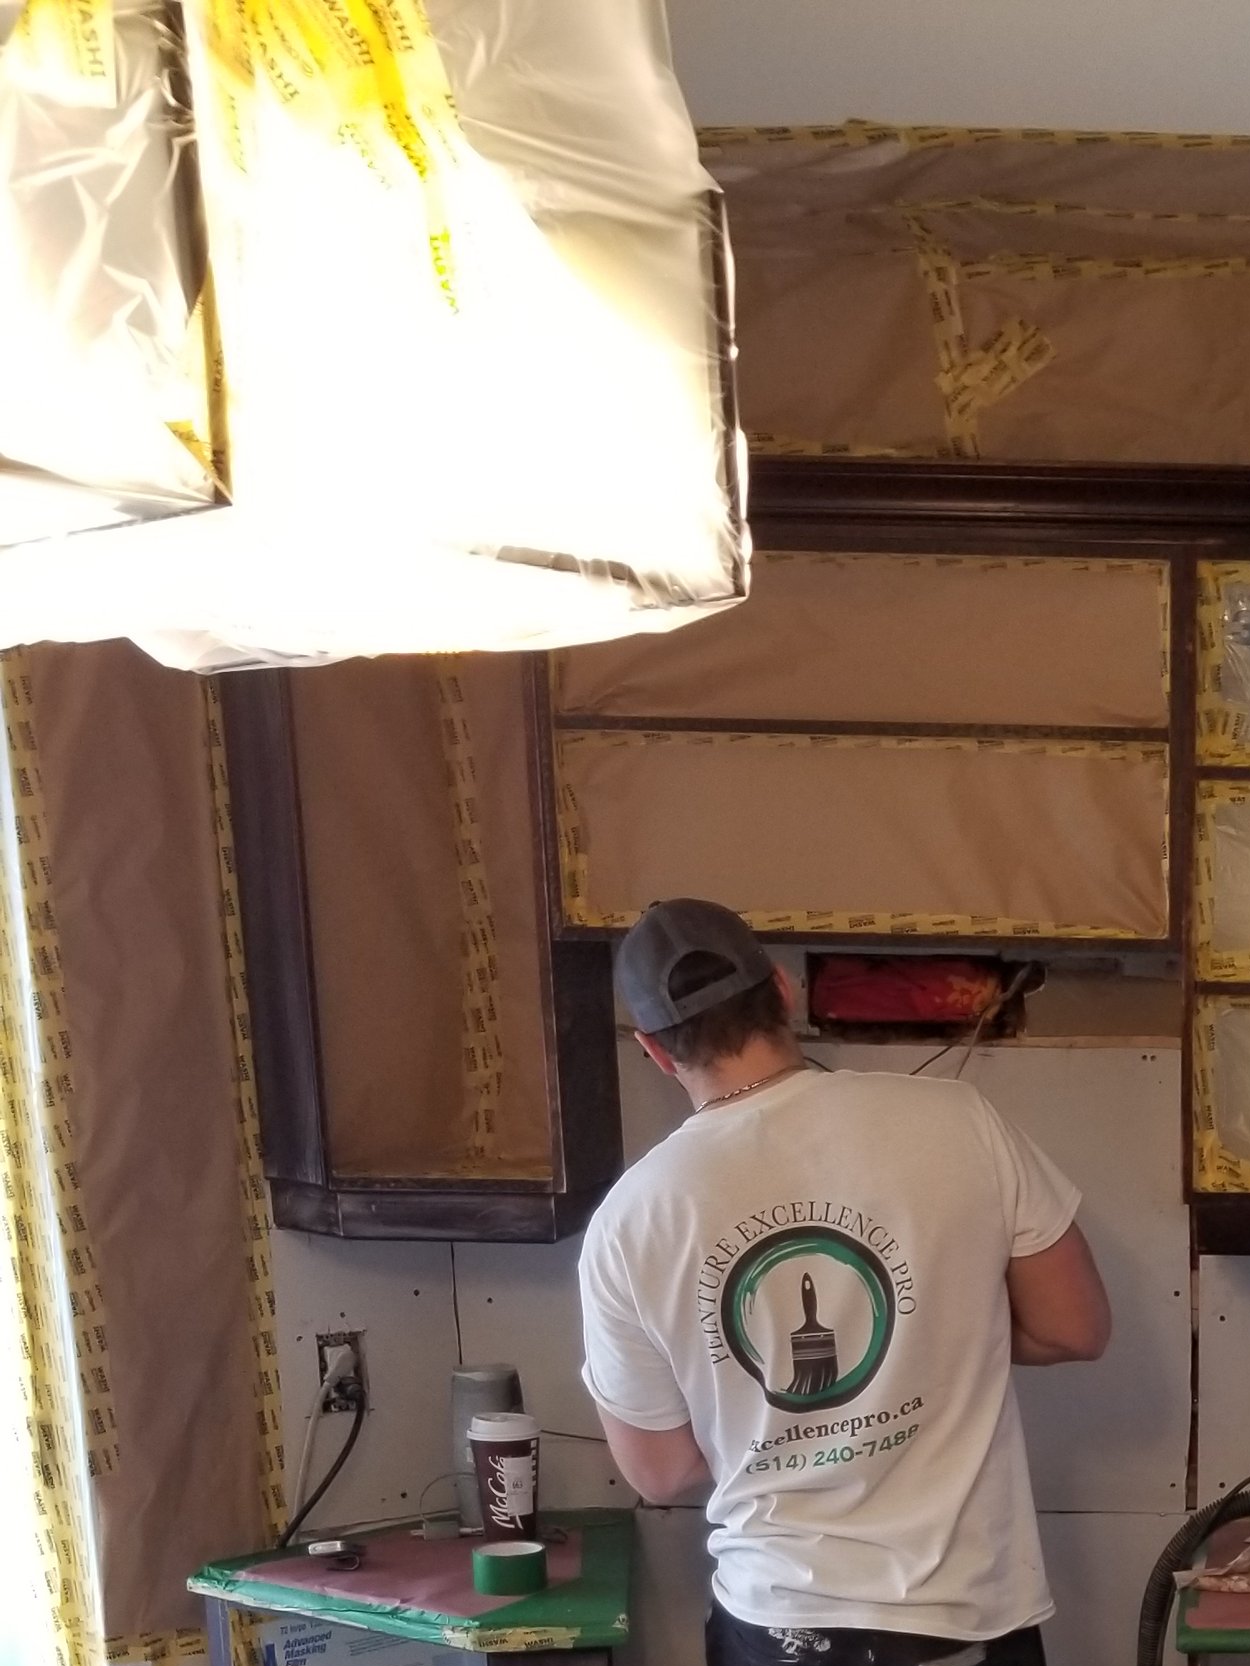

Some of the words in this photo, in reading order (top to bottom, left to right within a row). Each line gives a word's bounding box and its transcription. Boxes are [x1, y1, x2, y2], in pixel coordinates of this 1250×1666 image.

[698, 1238, 740, 1365] PEINTURE
[735, 1200, 900, 1261] EXCELLENCE
[891, 1261, 917, 1316] PRO
[745, 1449, 808, 1475] (514)
[812, 1423, 921, 1468] 240-7488
[749, 1395, 925, 1453] xcellencepro.ca
[283, 1631, 333, 1650] Advanced
[284, 1641, 327, 1661] Masking
